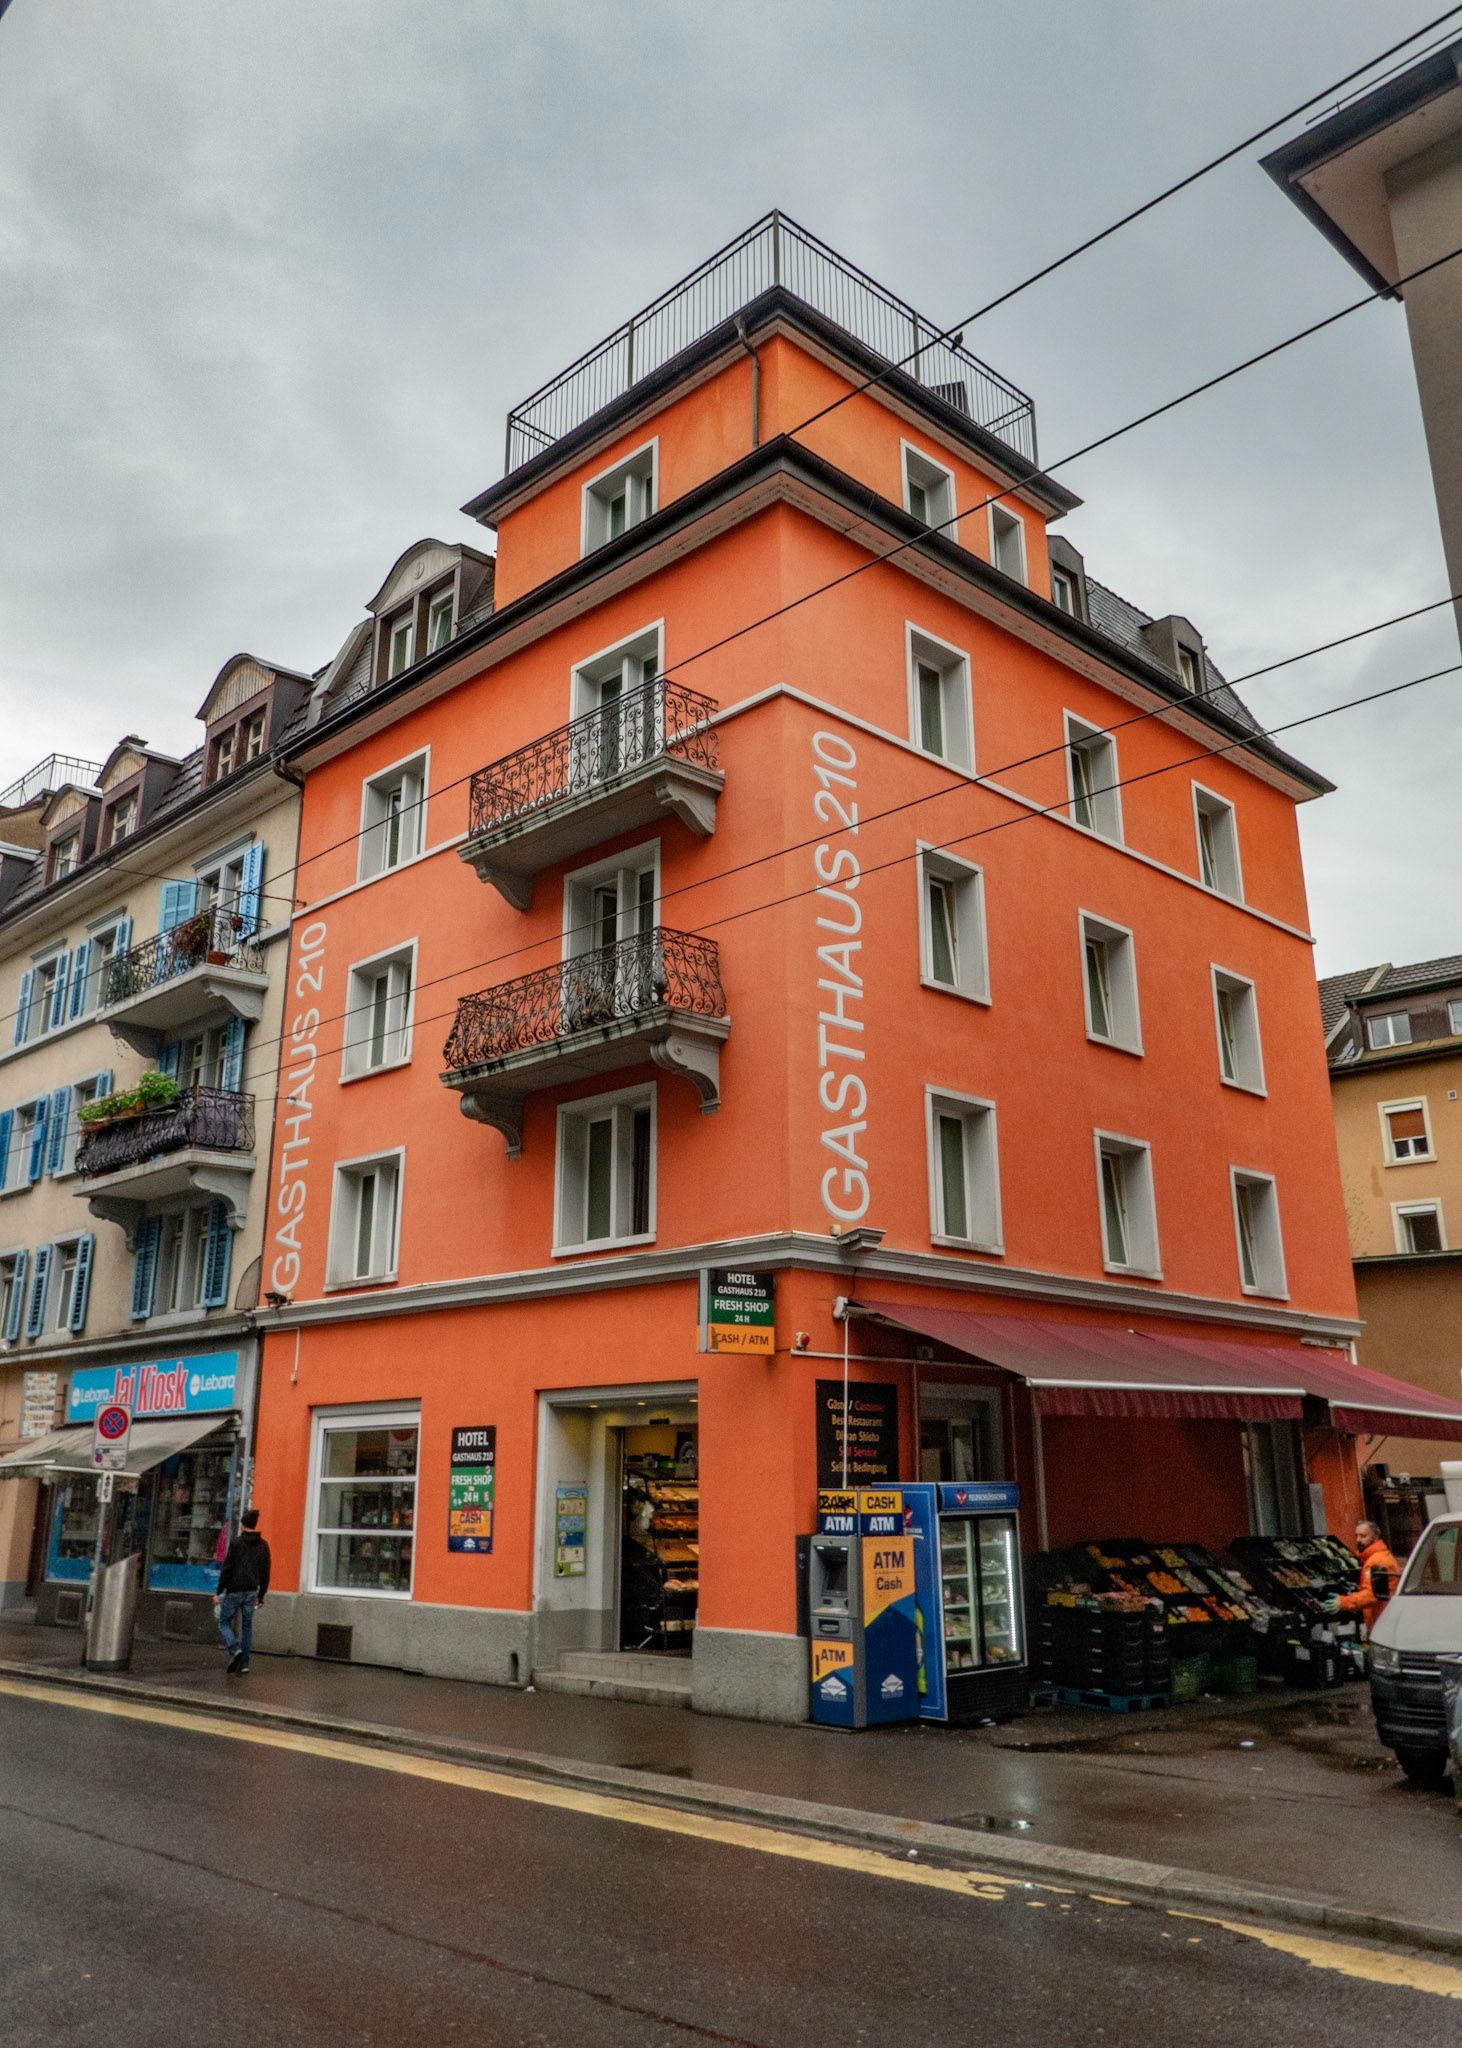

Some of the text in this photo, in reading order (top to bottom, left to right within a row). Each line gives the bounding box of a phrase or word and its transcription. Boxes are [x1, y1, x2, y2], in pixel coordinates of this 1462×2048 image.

[812, 730, 870, 1222] GASTHAUS 210
[271, 922, 327, 1294] GASTHAUS 210
[728, 1273, 757, 1285] HOTEL
[718, 1286, 766, 1297] GASTHAUS 210
[714, 1300, 769, 1312] FRESH SHOP
[734, 1314, 750, 1323] 24 H
[716, 1332, 769, 1346] CASH / ATM
[109, 1362, 189, 1412] Jai Kiosk
[200, 1375, 236, 1391] Lebara
[80, 1388, 109, 1402] Lebara
[458, 1431, 489, 1447] HOTEL
[452, 1452, 494, 1462] GASTHAUS 210
[854, 1447, 877, 1457] Service
[451, 1474, 493, 1486] FRESH SHOP
[463, 1492, 479, 1503] 24 H
[866, 1496, 896, 1509] CASH
[459, 1513, 482, 1524] CASH
[825, 1516, 853, 1531] ATM
[869, 1516, 894, 1531] ATM
[873, 1551, 905, 1570] ATM
[876, 1577, 902, 1591] Cash
[821, 1649, 845, 1662] ATM
